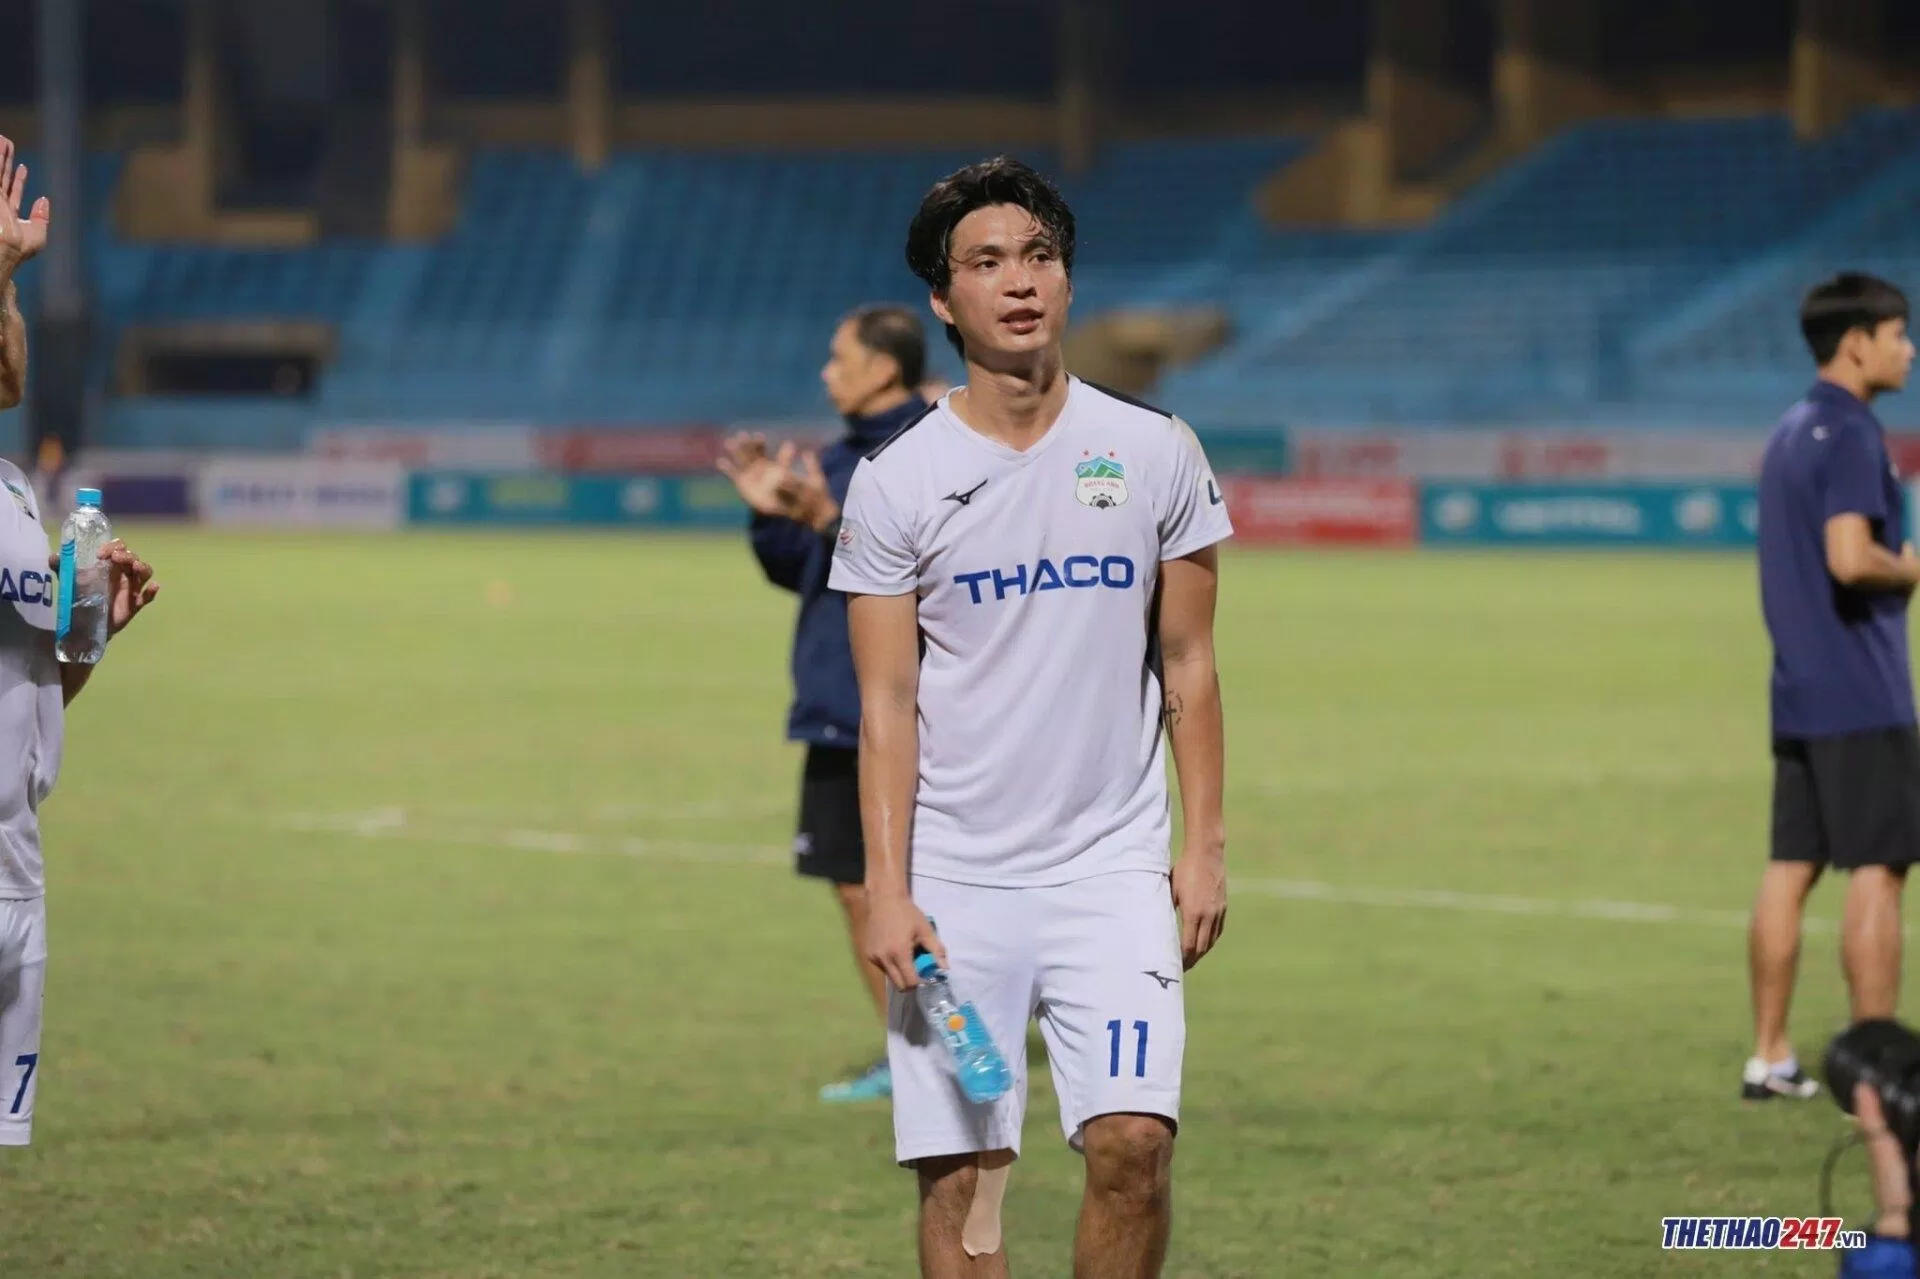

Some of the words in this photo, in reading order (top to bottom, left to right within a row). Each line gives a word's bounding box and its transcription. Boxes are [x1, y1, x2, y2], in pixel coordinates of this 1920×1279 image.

[954, 555, 1135, 604] THACO
[1106, 1019, 1148, 1077] 11
[10, 1053, 38, 1113] 7
